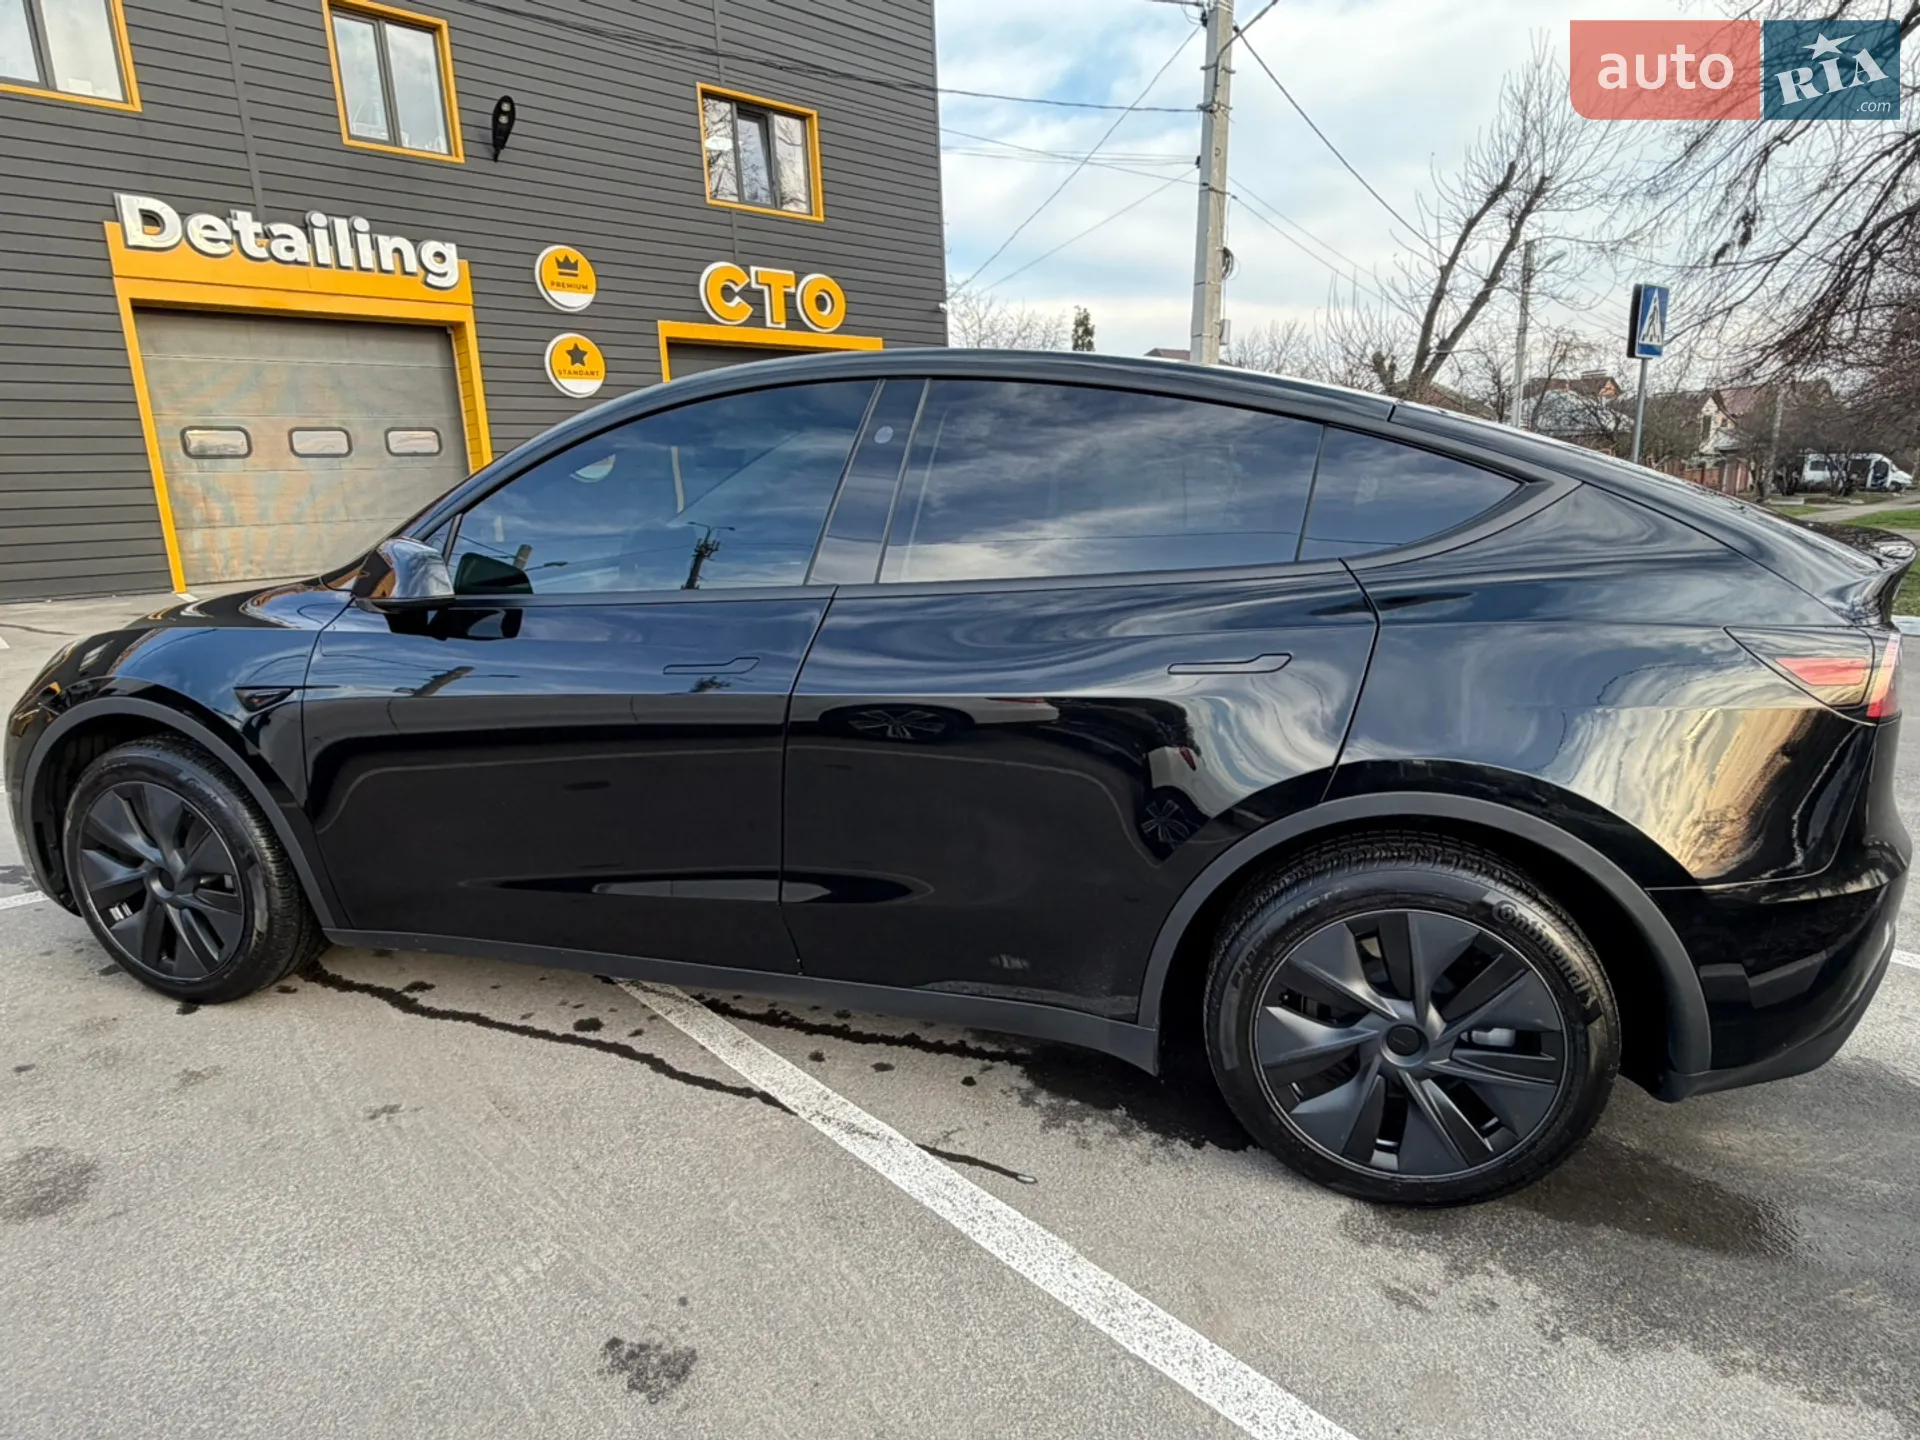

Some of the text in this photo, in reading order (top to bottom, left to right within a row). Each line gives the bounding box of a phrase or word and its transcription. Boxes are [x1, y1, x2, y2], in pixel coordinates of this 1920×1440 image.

[114, 192, 461, 290] Detailing
[550, 280, 588, 290] PREMIUM
[700, 261, 848, 333] СТО
[557, 369, 600, 377] STANDART
